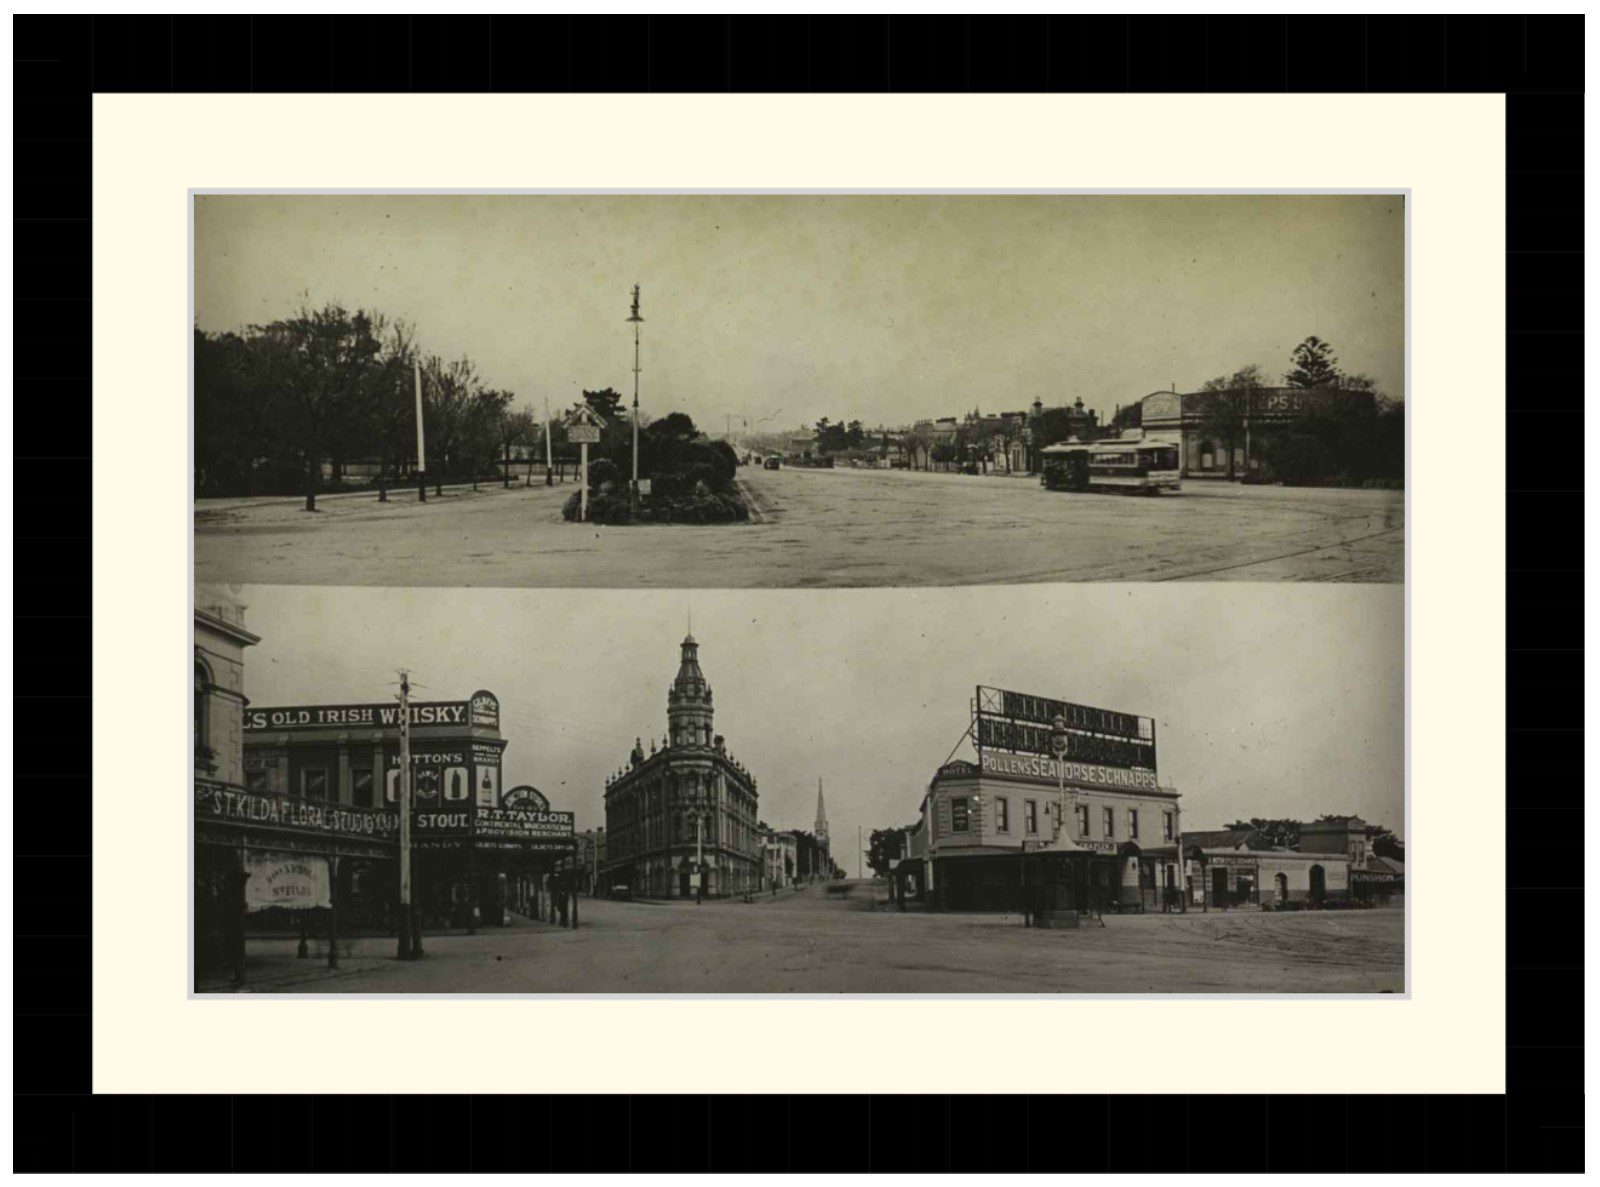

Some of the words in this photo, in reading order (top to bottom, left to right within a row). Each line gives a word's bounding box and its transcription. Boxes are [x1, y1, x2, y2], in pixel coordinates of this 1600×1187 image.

[272, 711, 310, 725] OLD
[319, 709, 374, 722] IRISH
[380, 706, 466, 724] WHISKY.
[392, 753, 463, 765] HTTON'S
[942, 767, 972, 776] HOTEL
[1098, 766, 1157, 790] SCHNAPPS
